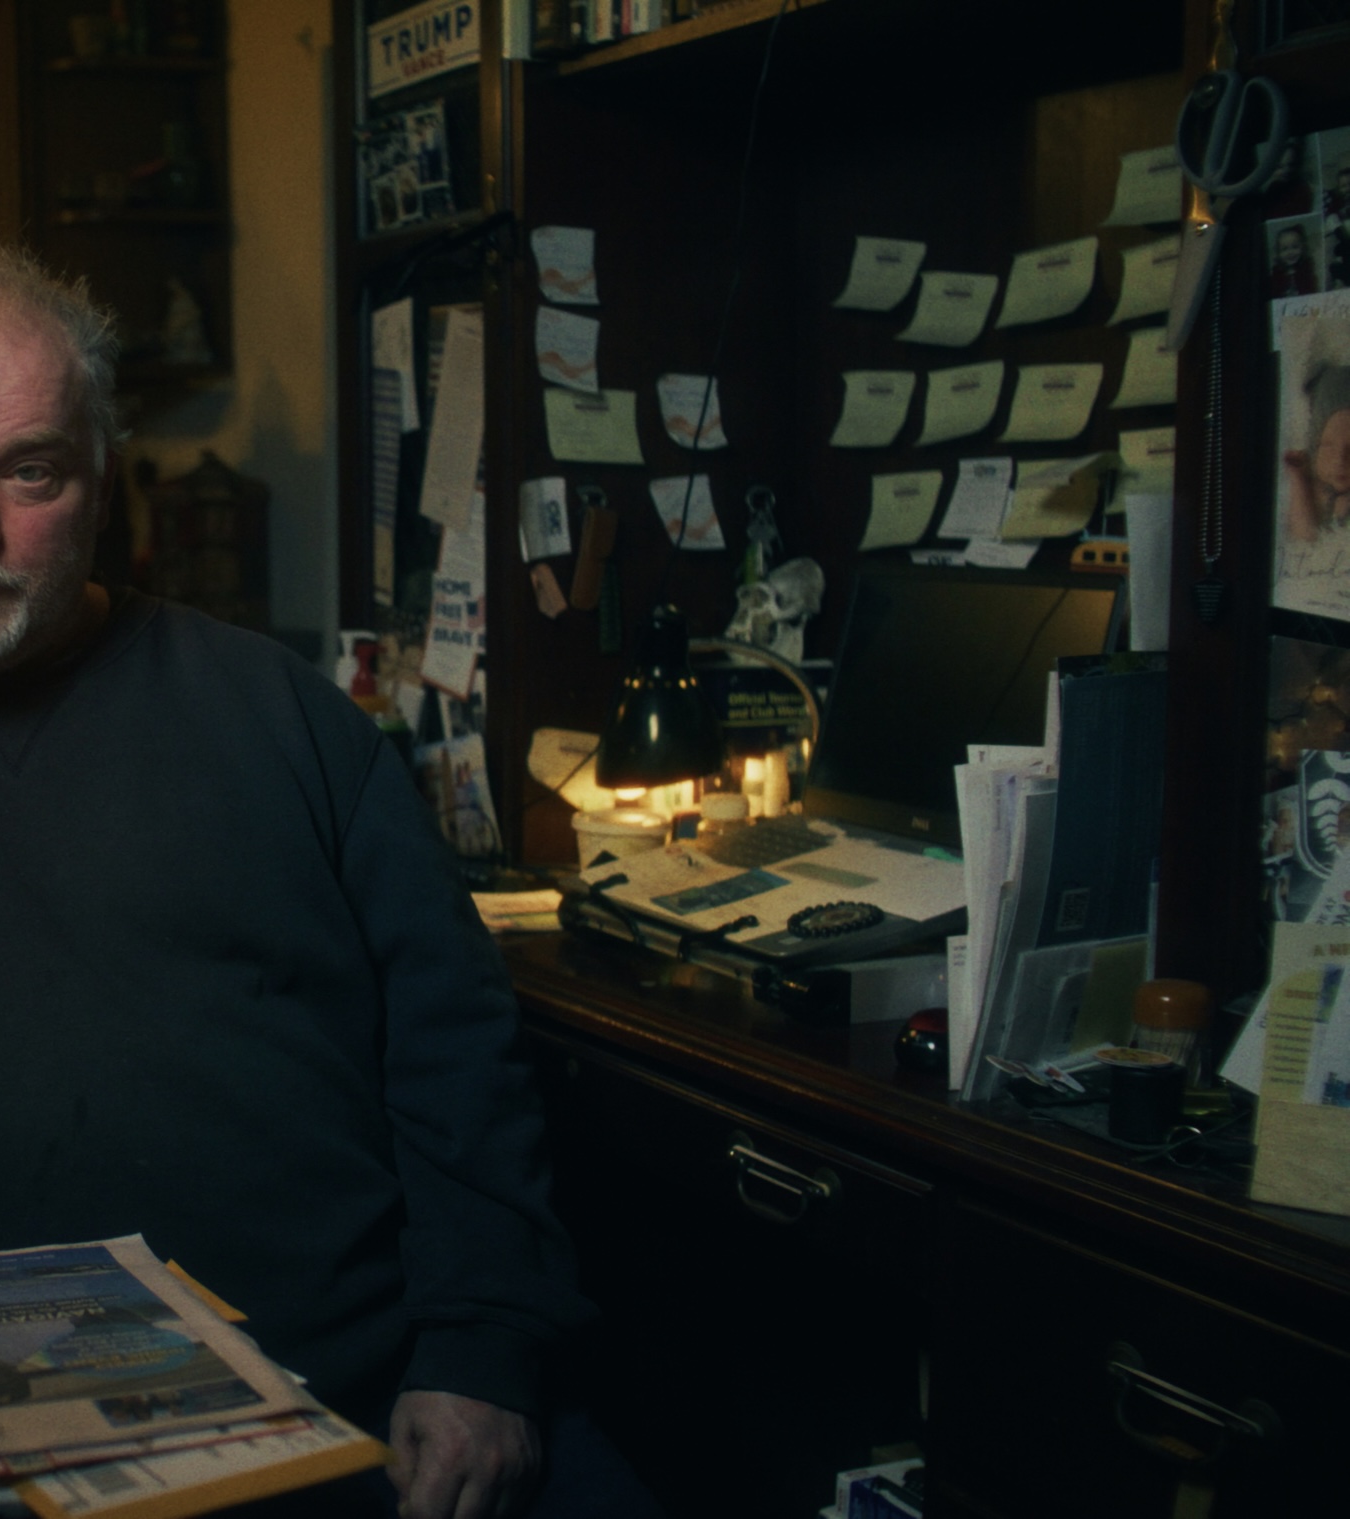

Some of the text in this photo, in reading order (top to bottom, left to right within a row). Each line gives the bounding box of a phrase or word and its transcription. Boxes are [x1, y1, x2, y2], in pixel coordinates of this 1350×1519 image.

[381, 5, 472, 66] TRUMP
[728, 693, 766, 705] Official
[728, 708, 748, 719] and
